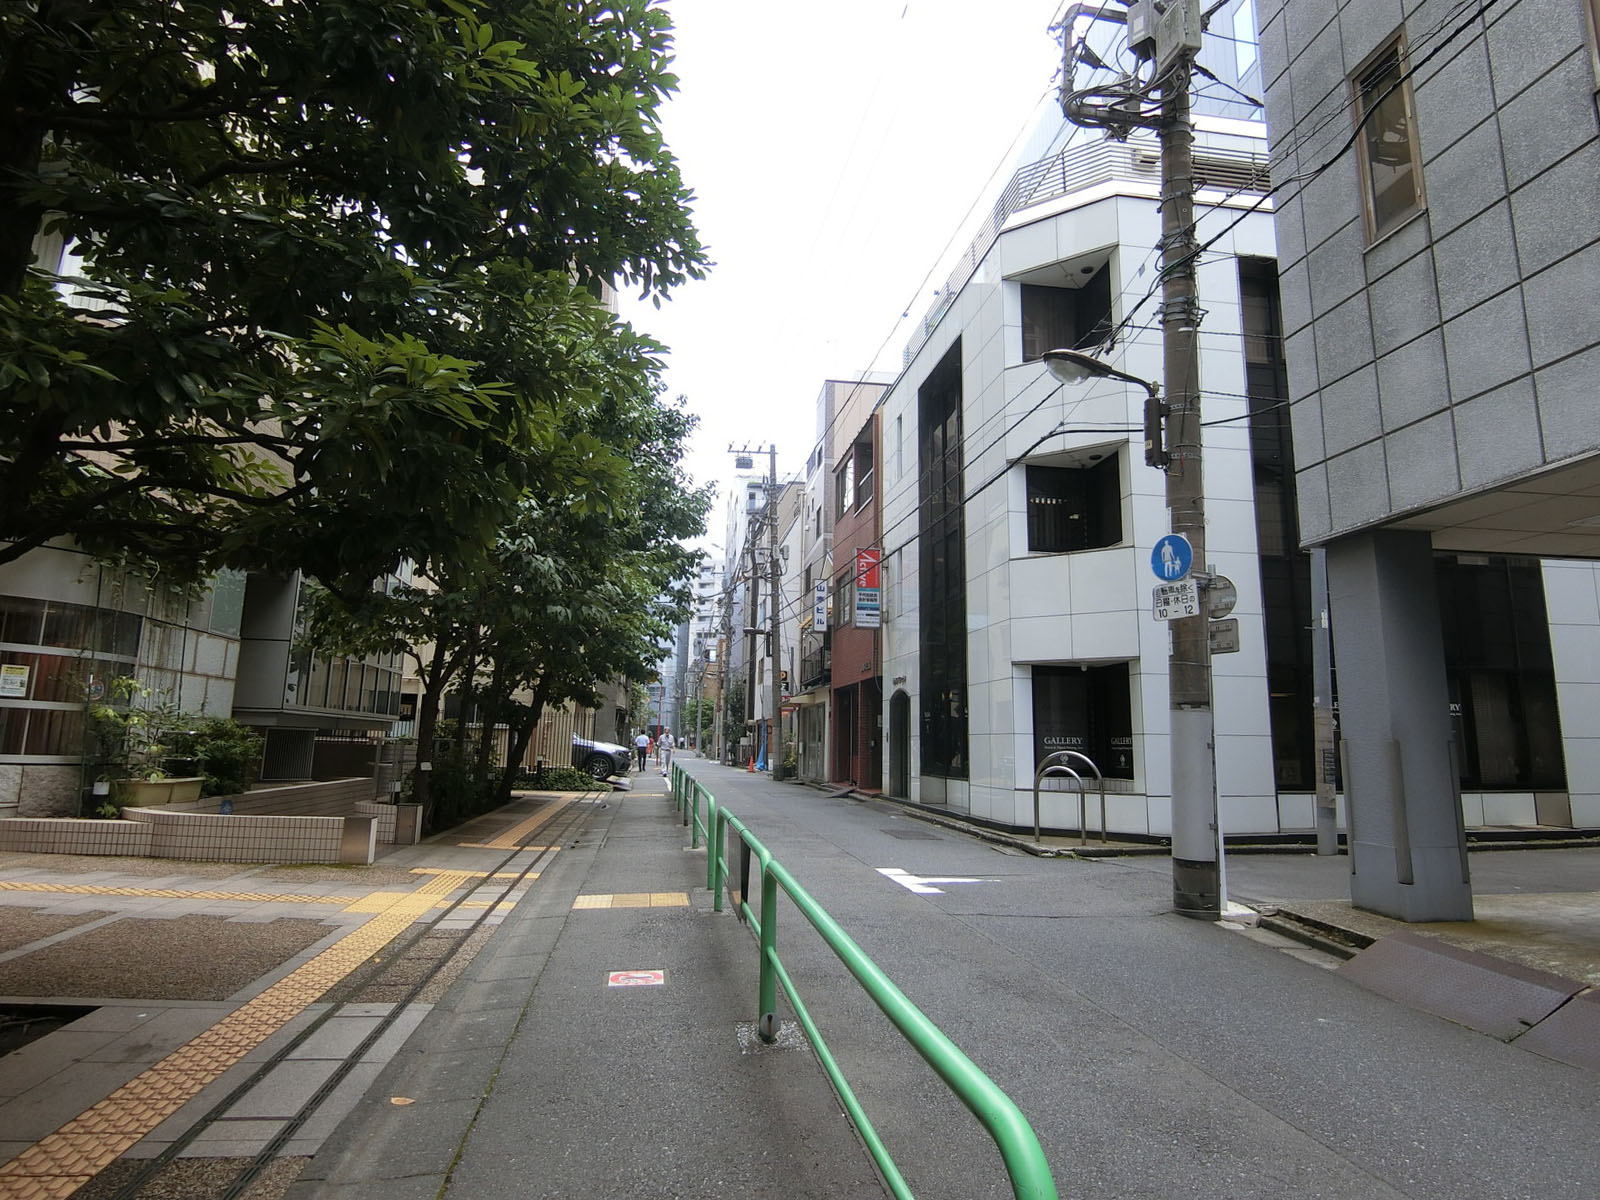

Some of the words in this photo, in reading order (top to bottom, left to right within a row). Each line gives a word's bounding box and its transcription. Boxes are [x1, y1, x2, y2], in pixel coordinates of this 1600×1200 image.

[1158, 608, 1168, 619] 10
[1184, 605, 1194, 615] 12
[1043, 736, 1083, 745] GALLERY
